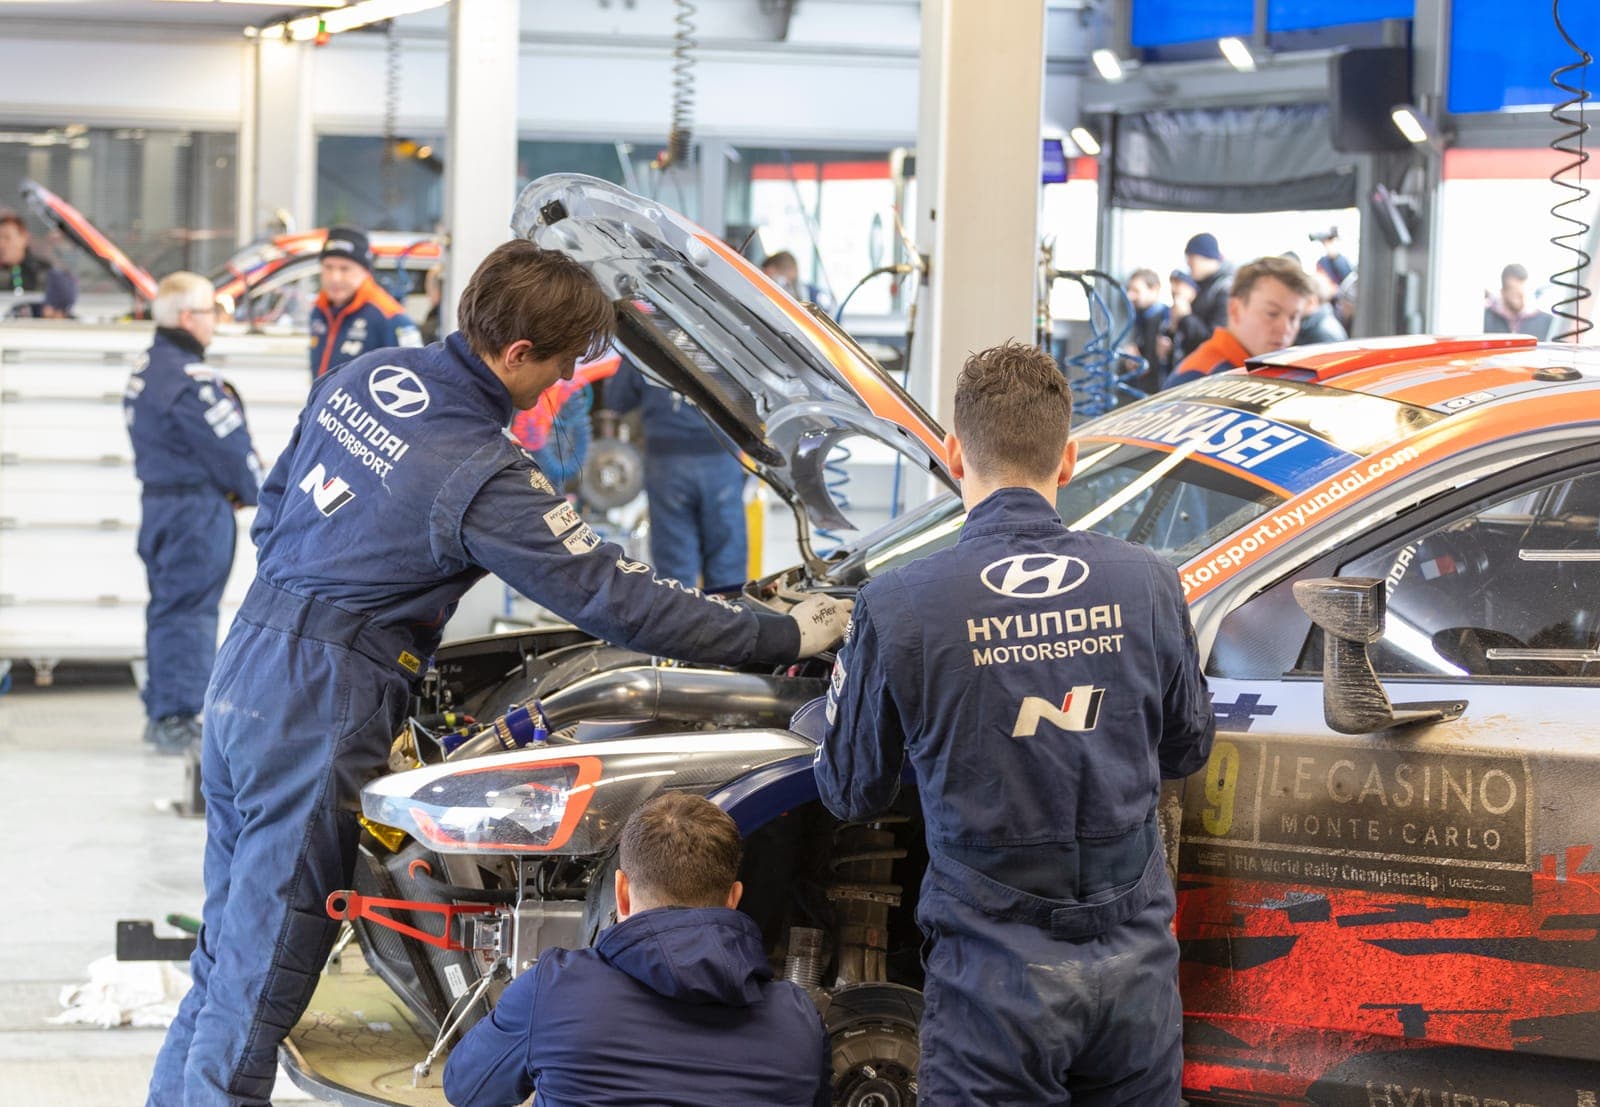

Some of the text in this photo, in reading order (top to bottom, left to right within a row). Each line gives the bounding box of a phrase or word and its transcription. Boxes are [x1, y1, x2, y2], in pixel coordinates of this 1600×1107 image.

[316, 407, 394, 479] MOTORSPORT
[327, 387, 410, 463] HYUNDAI
[966, 603, 1122, 643] HYUNDAI
[972, 634, 1125, 667] MOTORSPORT
[1270, 755, 1517, 815] LE CASINO
[1280, 814, 1500, 851] MONTE CARLO
[1260, 857, 1301, 875] World
[1304, 862, 1339, 882] Rally
[1341, 864, 1438, 891] Championship
